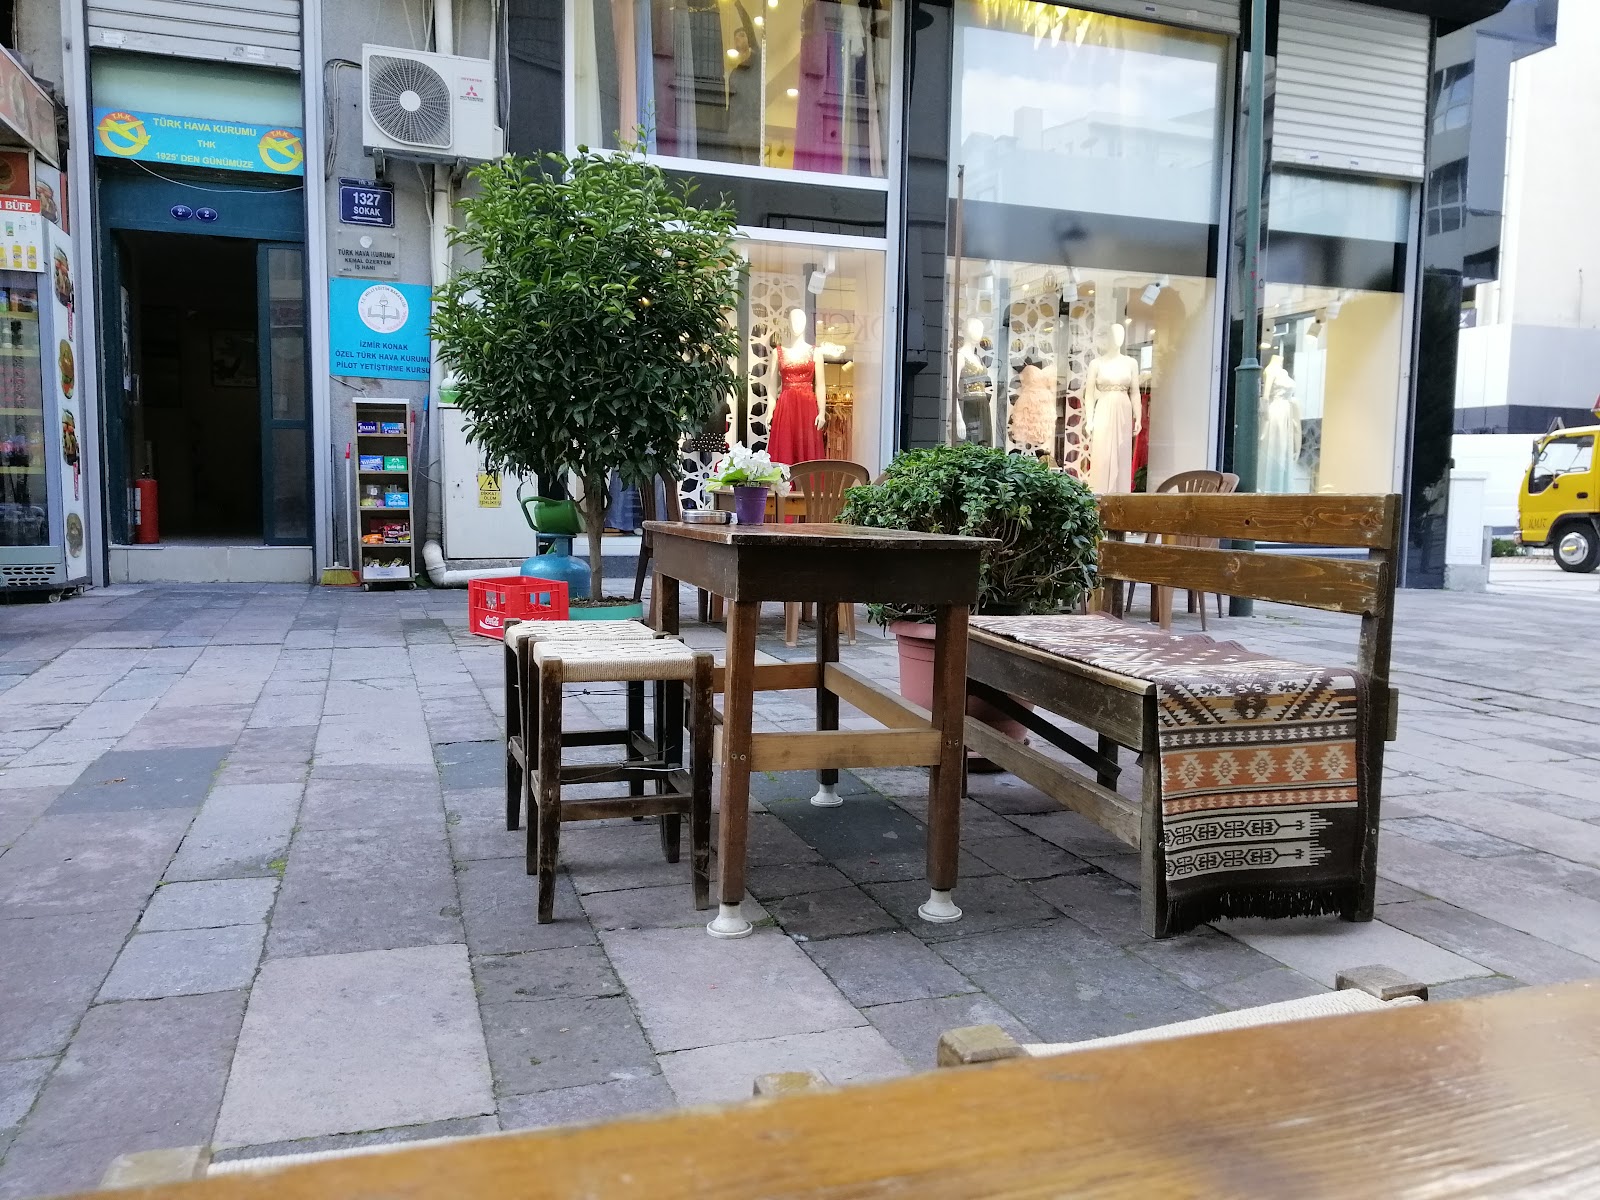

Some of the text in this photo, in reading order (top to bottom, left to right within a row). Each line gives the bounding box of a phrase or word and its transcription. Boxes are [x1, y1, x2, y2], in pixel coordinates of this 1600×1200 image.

[153, 117, 257, 136] TÜRK HAVA KURUMU
[197, 140, 216, 148] THK
[181, 154, 200, 163] DEN
[202, 156, 254, 168] GÜNÜMÜZE
[352, 192, 380, 206] 1327
[5, 200, 32, 212] BÜFE
[353, 206, 380, 216] SOKAK
[338, 248, 353, 256] TÜRK
[359, 340, 408, 350] İZMİR KONAK
[335, 350, 354, 358] ÖZEL
[356, 351, 377, 359] TÜRK
[400, 355, 430, 363] KURUMU
[360, 363, 403, 372] YETİŞTİRME
